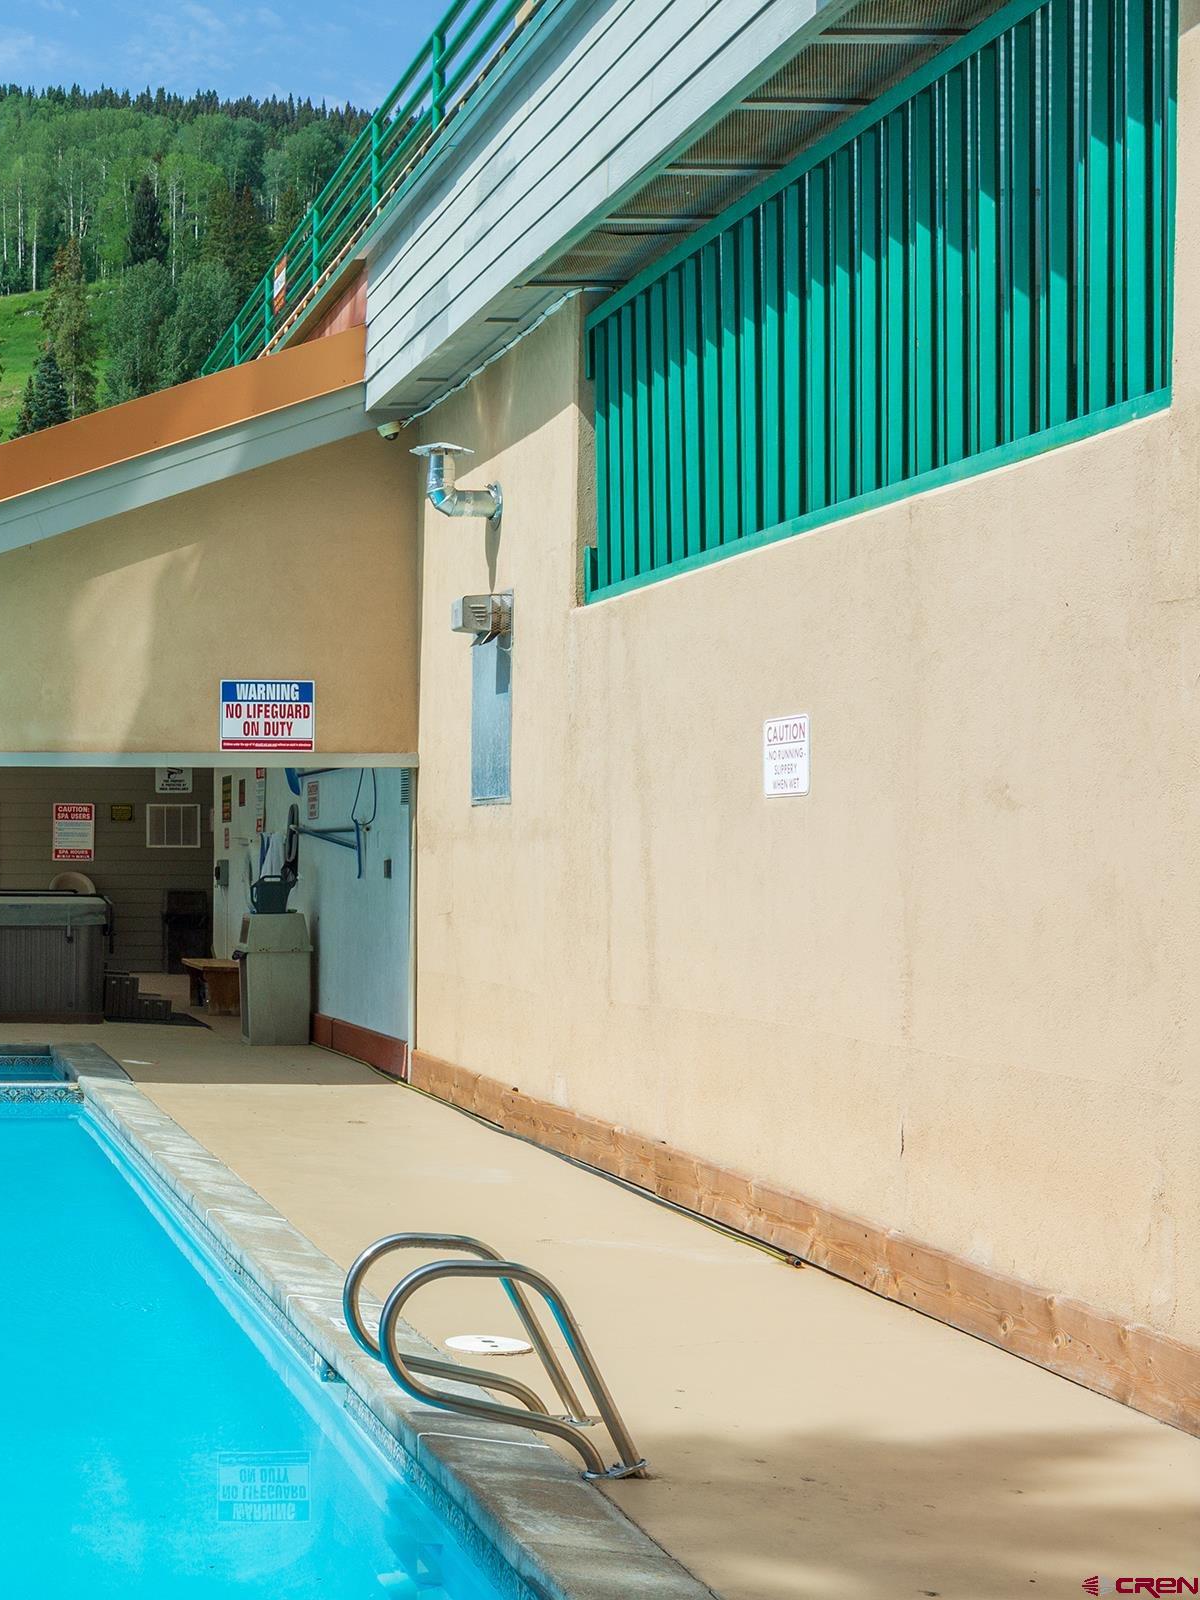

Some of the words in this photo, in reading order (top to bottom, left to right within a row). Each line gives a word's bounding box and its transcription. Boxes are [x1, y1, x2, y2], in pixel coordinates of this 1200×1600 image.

[236, 683, 300, 701] WARNING
[225, 703, 242, 719] NO
[246, 703, 310, 719] LIFEGUARD
[243, 721, 259, 736] ON
[264, 721, 293, 736] DUTY
[767, 722, 806, 743] CAUTION
[768, 749, 777, 760] NO
[773, 778, 788, 790] WHEN
[789, 777, 799, 789] WET
[70, 812, 90, 820] USERS
